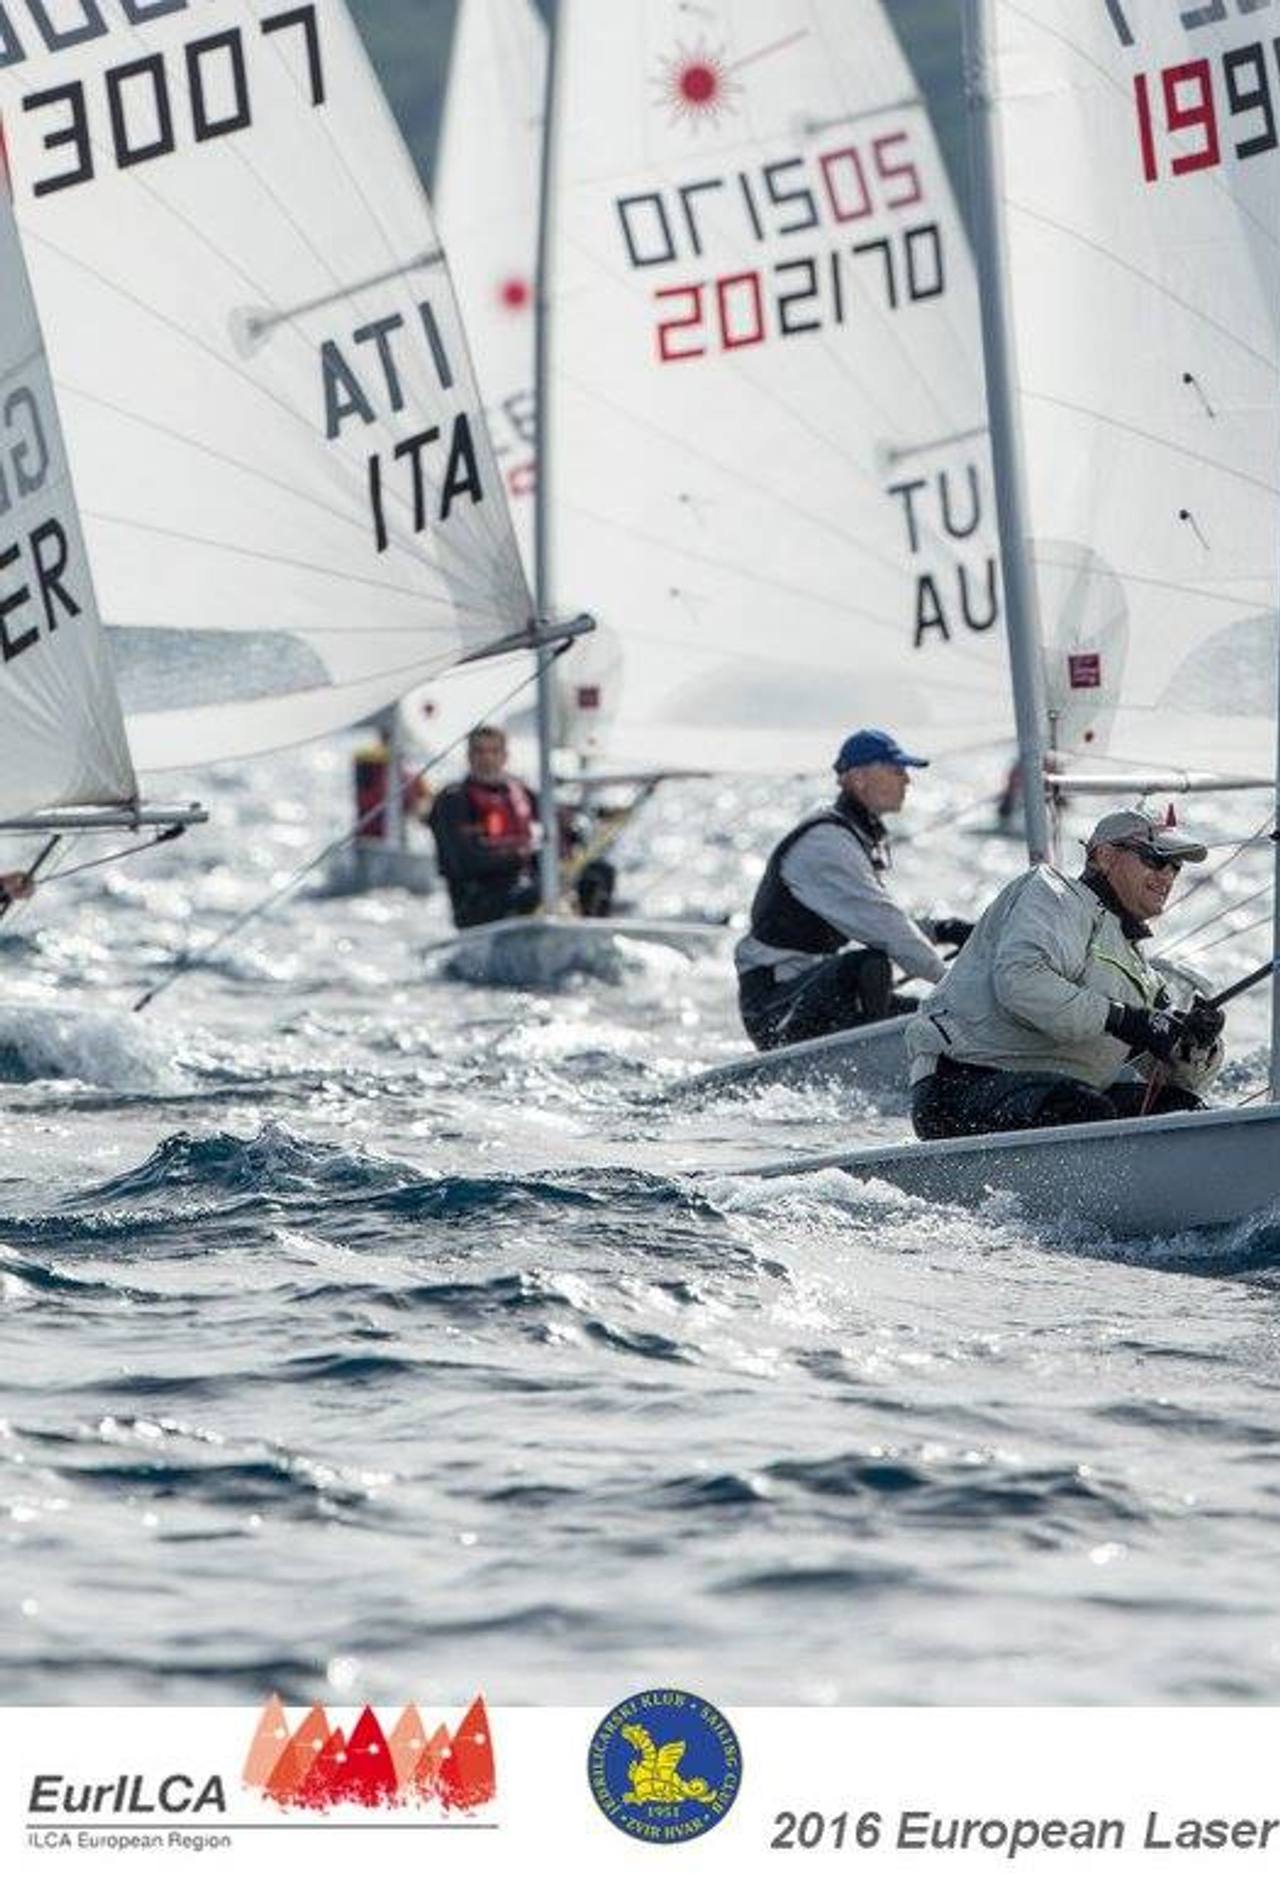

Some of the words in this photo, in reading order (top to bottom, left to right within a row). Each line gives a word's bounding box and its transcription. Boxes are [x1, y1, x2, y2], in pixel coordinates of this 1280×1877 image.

[22, 4, 326, 197] 3007
[655, 221, 947, 362] 202170
[369, 412, 483, 553] ITA
